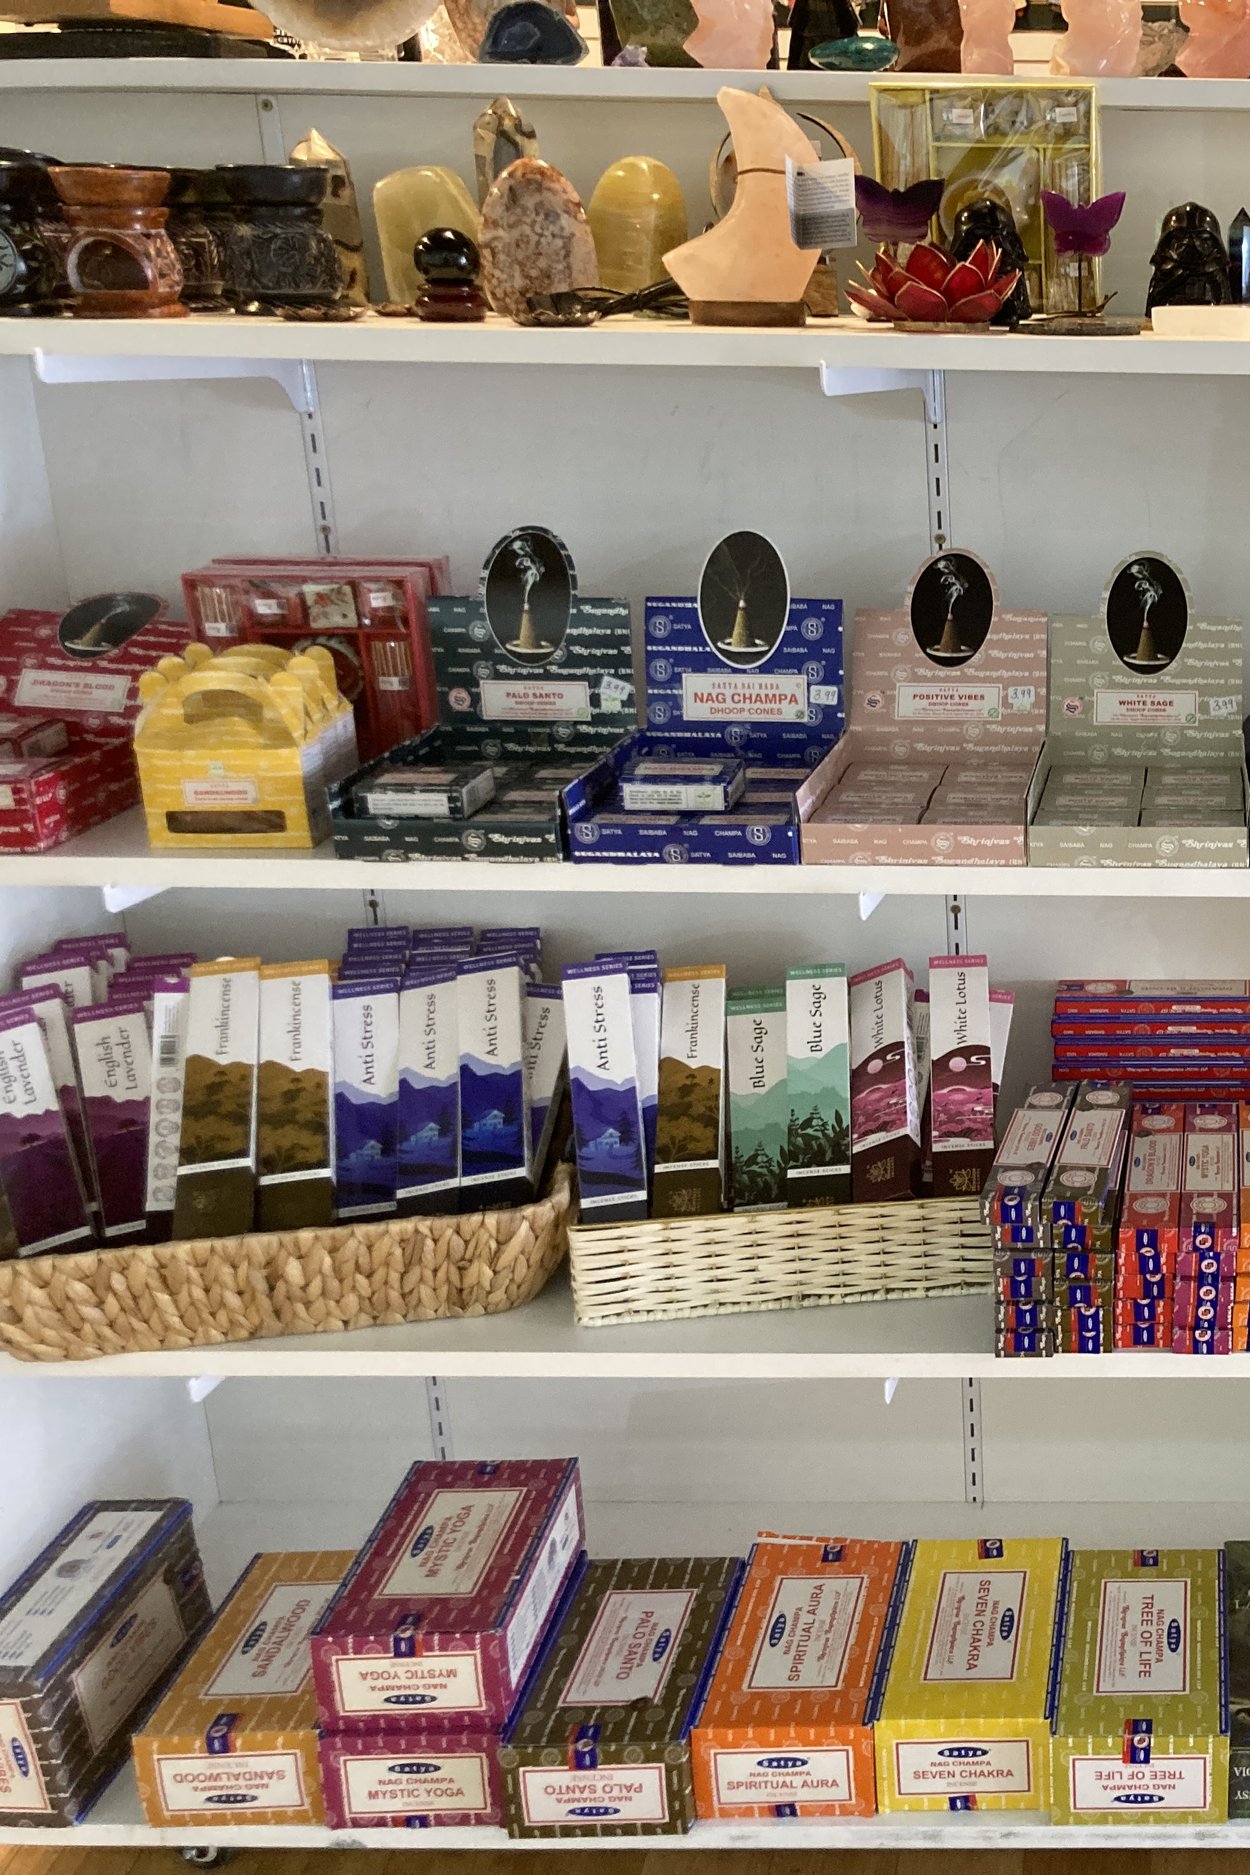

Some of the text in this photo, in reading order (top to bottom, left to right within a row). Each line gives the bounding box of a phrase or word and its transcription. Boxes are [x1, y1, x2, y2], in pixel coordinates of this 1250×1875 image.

[505, 691, 564, 701] PALO SANTO
[693, 691, 799, 705] NAG CHAMPA
[710, 706, 783, 716] DHOOP CONES
[912, 693, 956, 701] POSITIVE
[1118, 699, 1148, 707] WHITE
[567, 962, 624, 975] WELLNESS SERIES
[214, 978, 232, 1056] Frankincense
[286, 981, 302, 1061] Frankincense
[423, 992, 437, 1070] Anti Stress
[484, 977, 499, 1057] Anti Stress
[528, 1006, 551, 1051] Stress
[592, 985, 611, 1071] Anti Stress
[686, 983, 701, 1059] Frankincense
[806, 983, 827, 1053] Blue Sage
[871, 979, 884, 1049] White Lotus
[953, 971, 968, 1046] White Lotus
[98, 1034, 118, 1088] English
[117, 1026, 138, 1090] Lavender
[361, 1003, 376, 1086] Anti Stress
[749, 1018, 768, 1089] Blue Sage
[9, 1040, 37, 1105] Lavender
[424, 1504, 475, 1578] MYSTIC YOGA
[252, 1599, 311, 1678] SANDALWOOD
[615, 1610, 655, 1681] PALO SANTO
[783, 1606, 804, 1656] NAG CHAMPA
[787, 1582, 827, 1683] SPIRITUAL AURA
[965, 1579, 992, 1672] SEVEN CHAKRA
[986, 1599, 1001, 1648] NAG CHAMPA
[1138, 1594, 1155, 1679] TREE OF LIFE
[1154, 1608, 1165, 1664] NAG CHAMPA
[358, 1668, 458, 1682] MYSTIC YOGA
[369, 1682, 448, 1692] NAG CHAMPA
[173, 1769, 287, 1784] SANDALWOOD
[749, 1770, 771, 1778] NAG
[761, 1759, 803, 1768] Satya
[912, 1768, 1015, 1780] SEVEN CHAKRA
[943, 1748, 983, 1757] Satya
[1094, 1770, 1185, 1781] TREE OF LIFE
[192, 1782, 270, 1792] NAG CHAMPA
[367, 1787, 466, 1801] MYSTIC YOGA
[378, 1777, 455, 1786] NAG CHAMPA
[544, 1782, 644, 1796] PALO SANTO
[555, 1796, 603, 1804] CHAMPA
[726, 1778, 840, 1791] SPIRITUAL AURA
[1101, 1783, 1176, 1791] NAG CHAMPA
